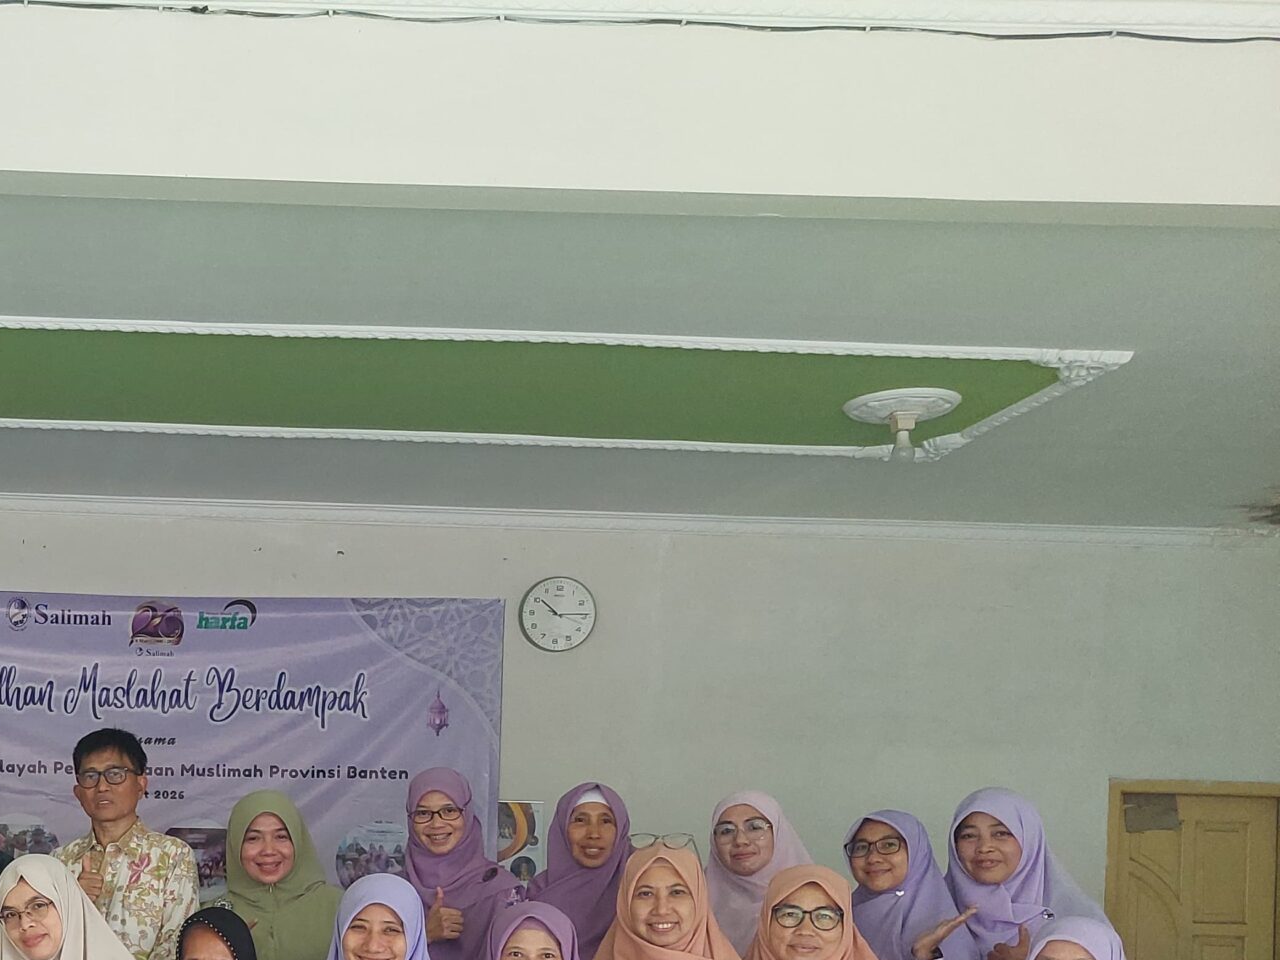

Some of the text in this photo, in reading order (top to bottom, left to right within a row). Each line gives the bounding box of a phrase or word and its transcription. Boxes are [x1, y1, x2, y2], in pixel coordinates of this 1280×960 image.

[34, 603, 112, 626] Salimah
[196, 611, 248, 630] harfa
[64, 662, 198, 720] Maslahat
[206, 666, 368, 729] Berdampak
[180, 763, 264, 779] Muslimah
[269, 765, 341, 780] Provinsi
[347, 766, 410, 780] Banten
[154, 790, 185, 800] 2026
